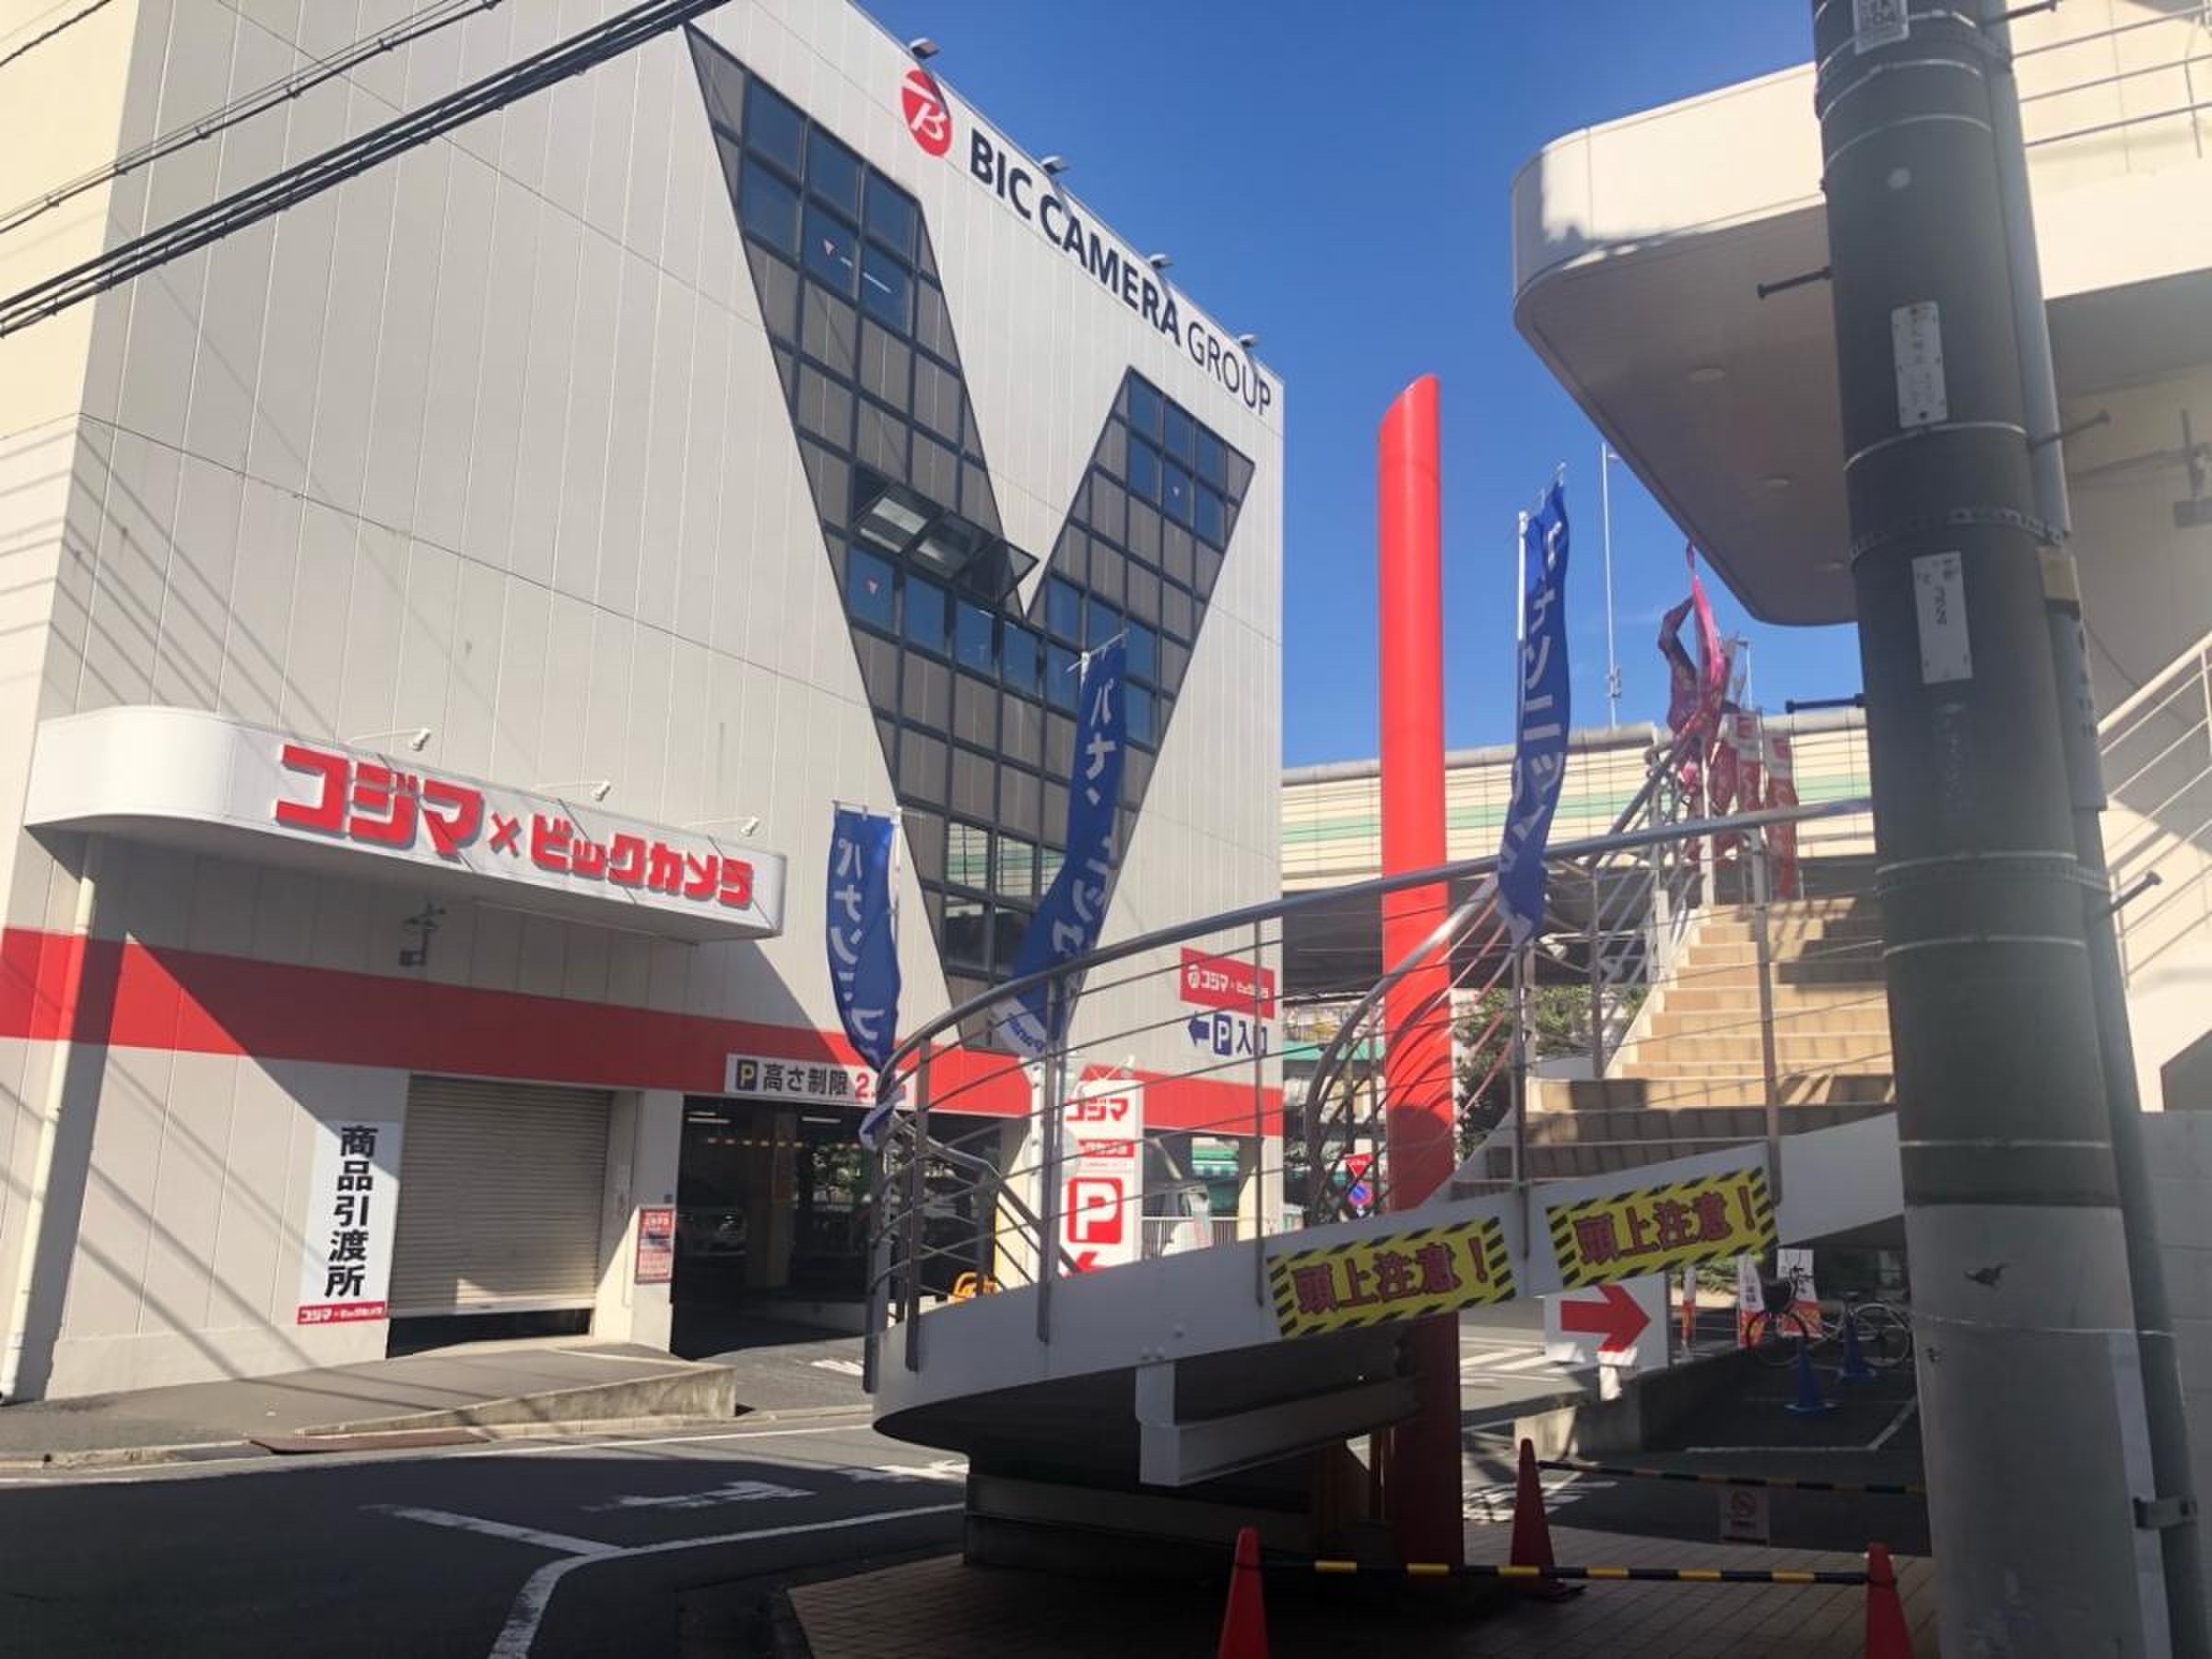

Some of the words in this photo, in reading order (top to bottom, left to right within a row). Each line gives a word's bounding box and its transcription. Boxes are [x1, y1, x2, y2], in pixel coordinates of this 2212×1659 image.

[971, 128, 1032, 220] BIC
[1040, 194, 1182, 347] CAMERA
[1187, 322, 1271, 417] GROUP
[739, 1063, 755, 1088] P
[764, 1064, 847, 1095] 高さ制限
[1066, 1097, 1129, 1122] コジマ
[324, 1125, 379, 1299] 商品引渡所
[1073, 1181, 1119, 1241] P
